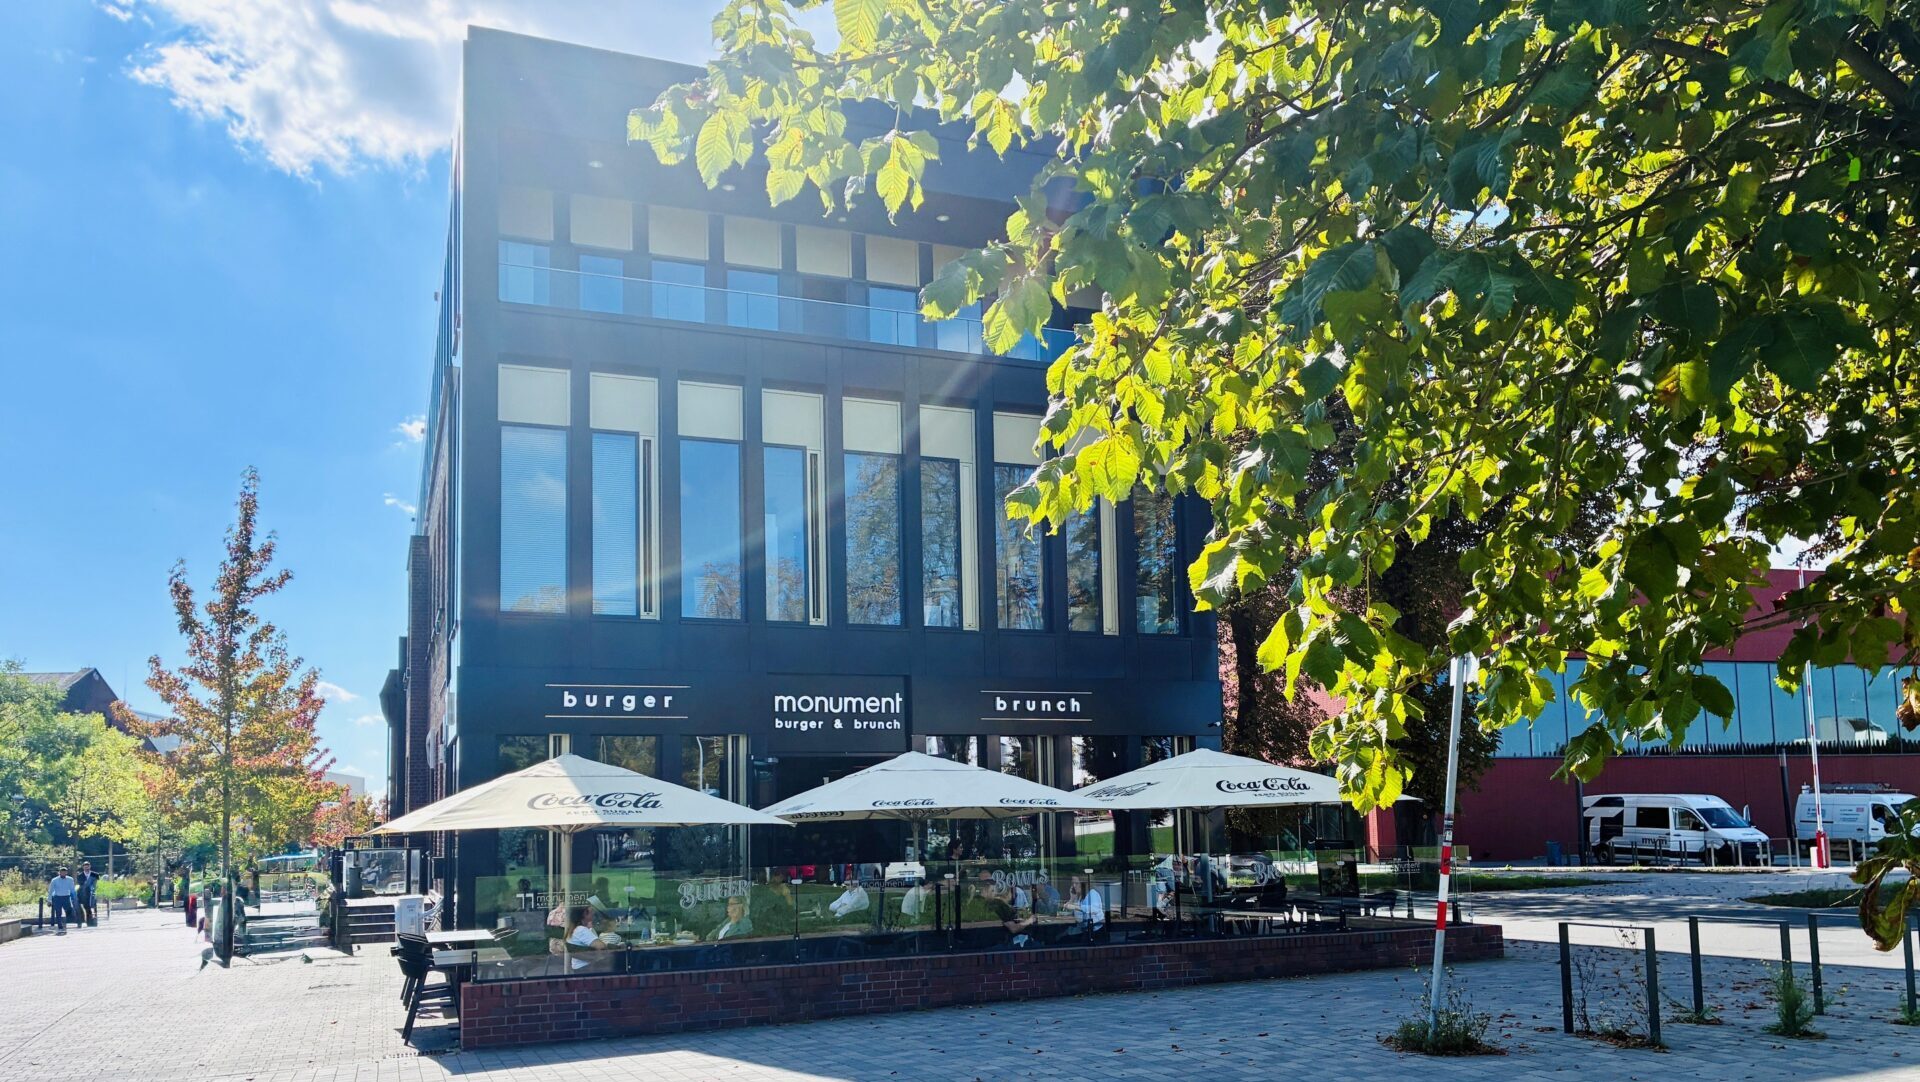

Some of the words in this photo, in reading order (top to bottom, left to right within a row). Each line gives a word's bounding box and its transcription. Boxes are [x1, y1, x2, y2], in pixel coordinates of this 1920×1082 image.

[563, 691, 673, 712] burger
[774, 692, 903, 714] monument
[995, 696, 1081, 712] brunch
[775, 718, 824, 732] burger
[833, 718, 844, 729] &
[853, 718, 901, 729] brunch
[1215, 777, 1311, 793] Coca-Cola
[527, 791, 664, 811] Coca-Cola
[872, 798, 937, 807] Coca-Cola
[999, 797, 1061, 806] Coca-Cola
